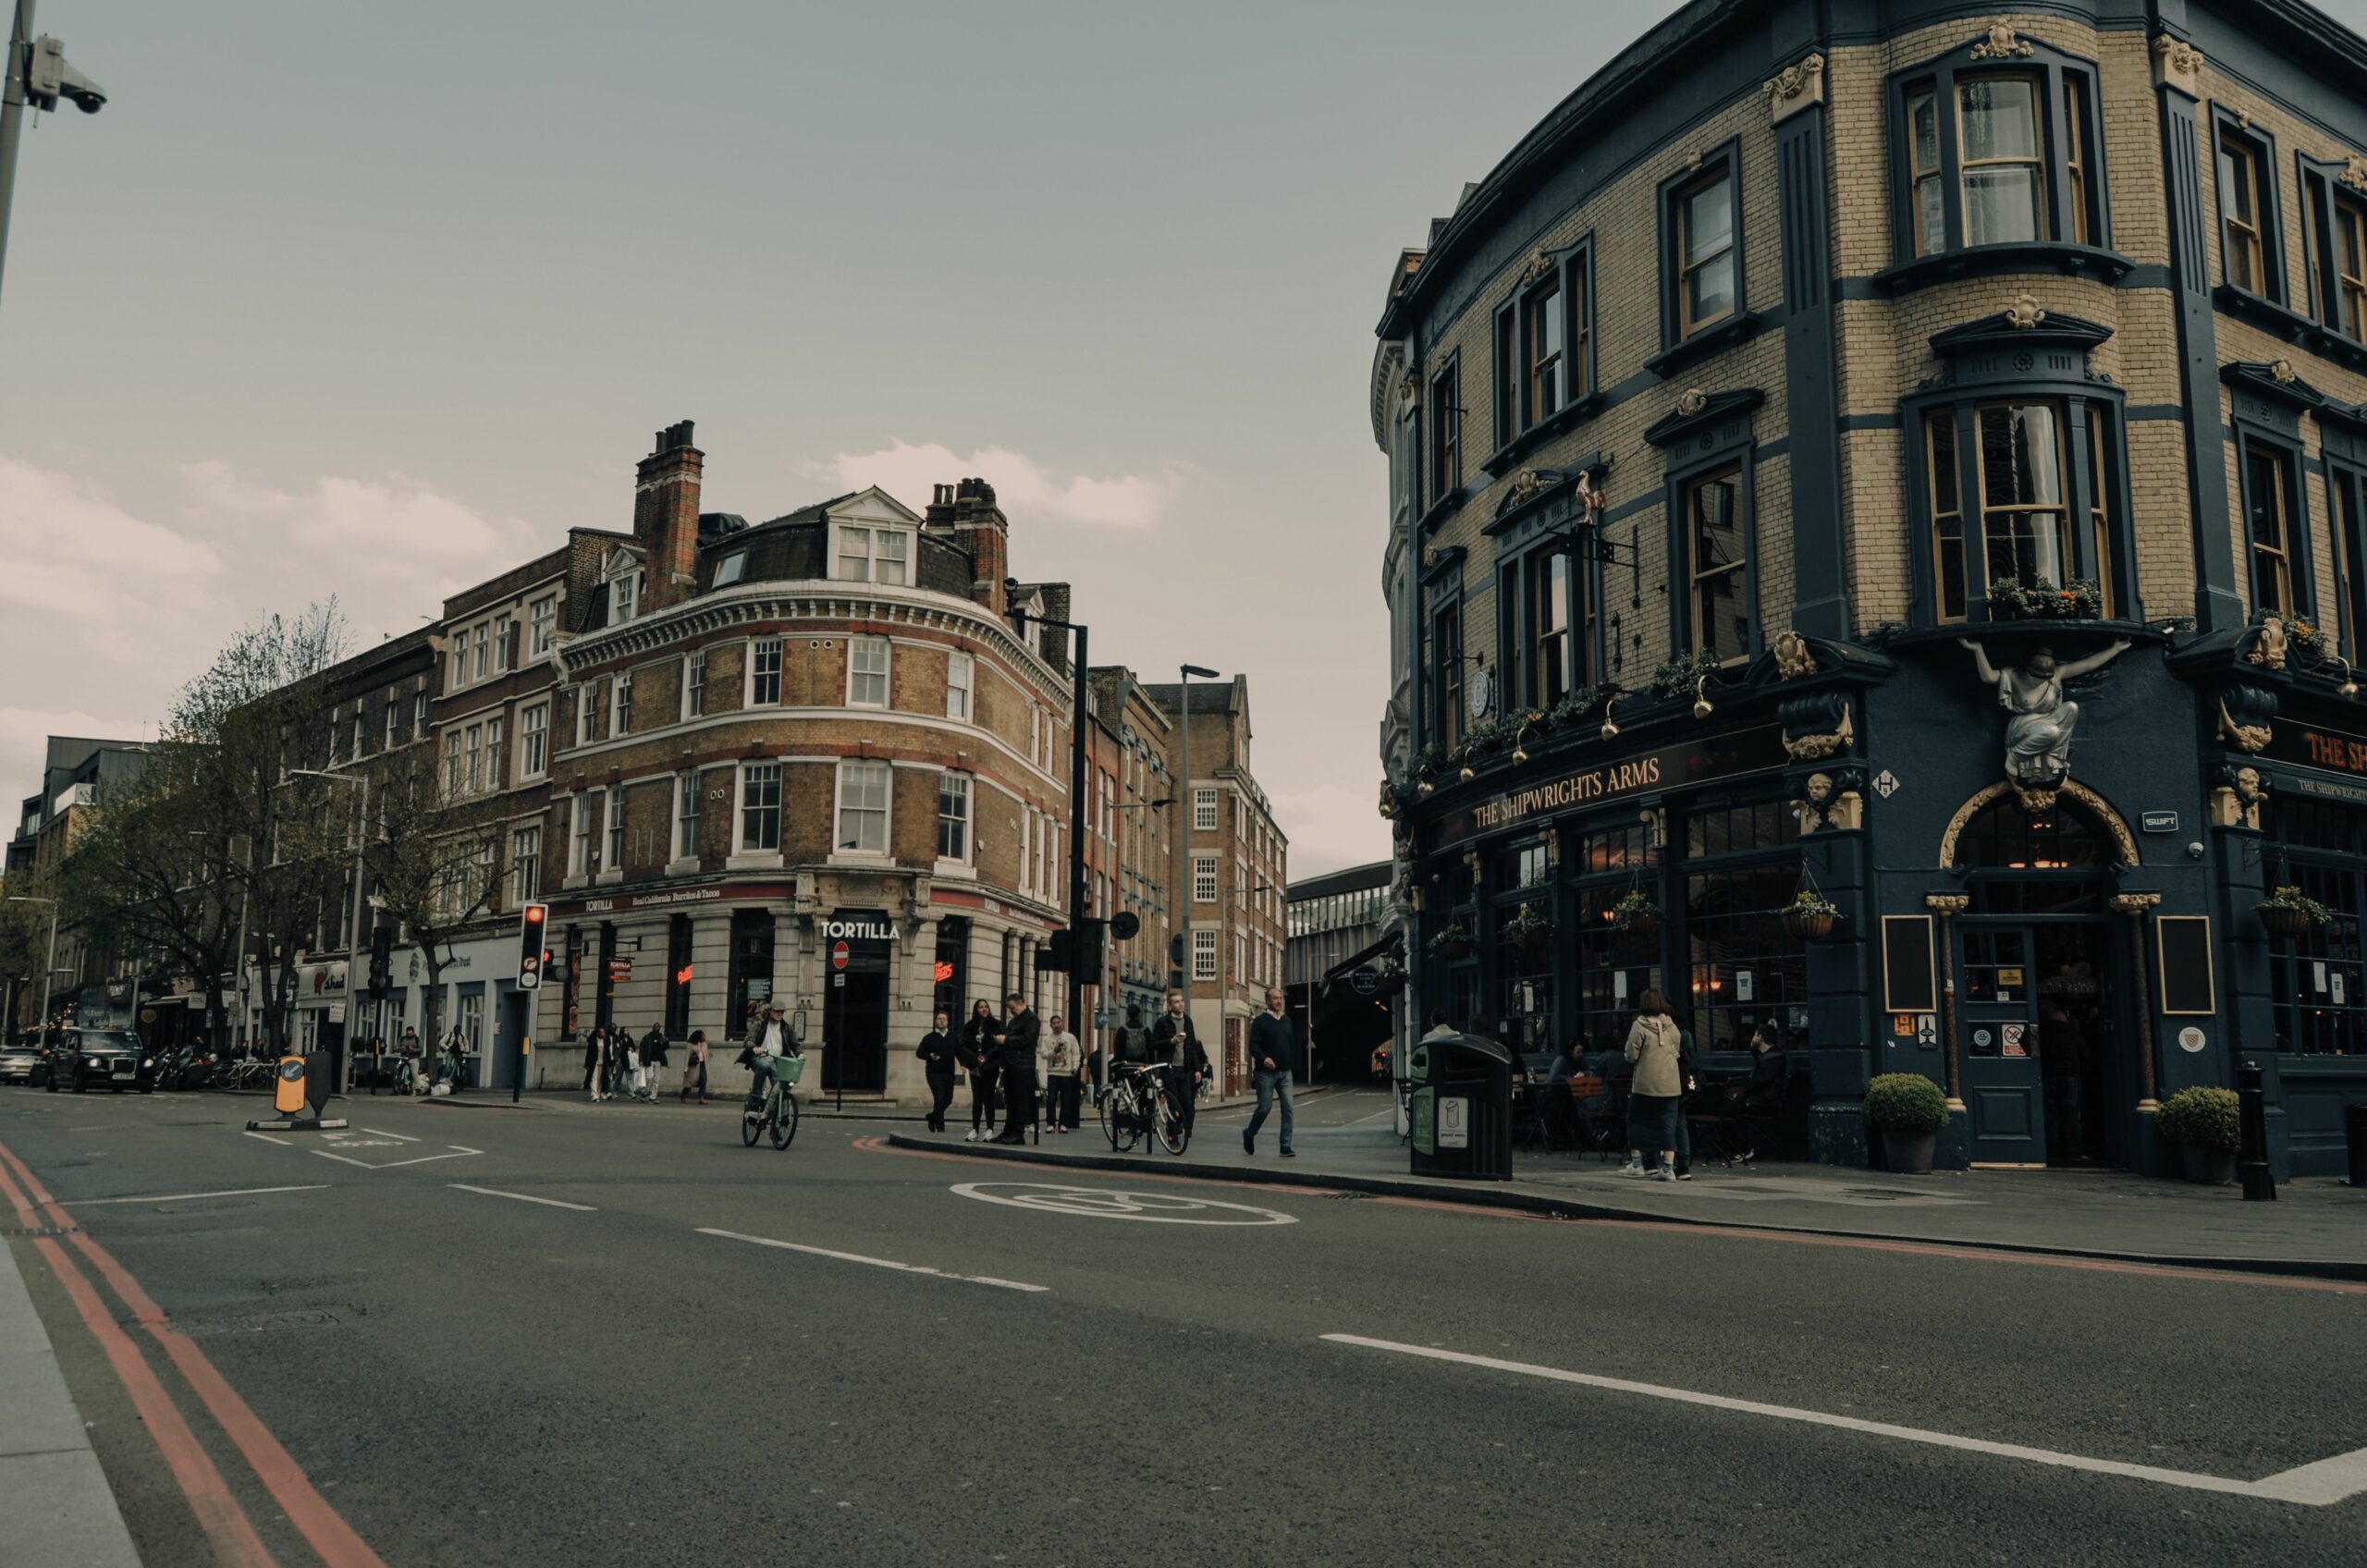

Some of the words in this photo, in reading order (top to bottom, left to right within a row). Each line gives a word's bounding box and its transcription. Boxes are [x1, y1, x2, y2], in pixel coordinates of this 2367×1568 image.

[2306, 732, 2346, 767] THE
[1474, 802, 1499, 828] THE
[1501, 771, 1602, 821] SHIPWRIGHTS
[1606, 757, 1661, 793] ARMS
[2298, 779, 2316, 792] THE
[586, 900, 613, 913] TORTILLA
[644, 894, 671, 905] California
[673, 892, 696, 902] Burritos
[702, 889, 720, 899] Tacos
[821, 921, 901, 939] TORTILLA
